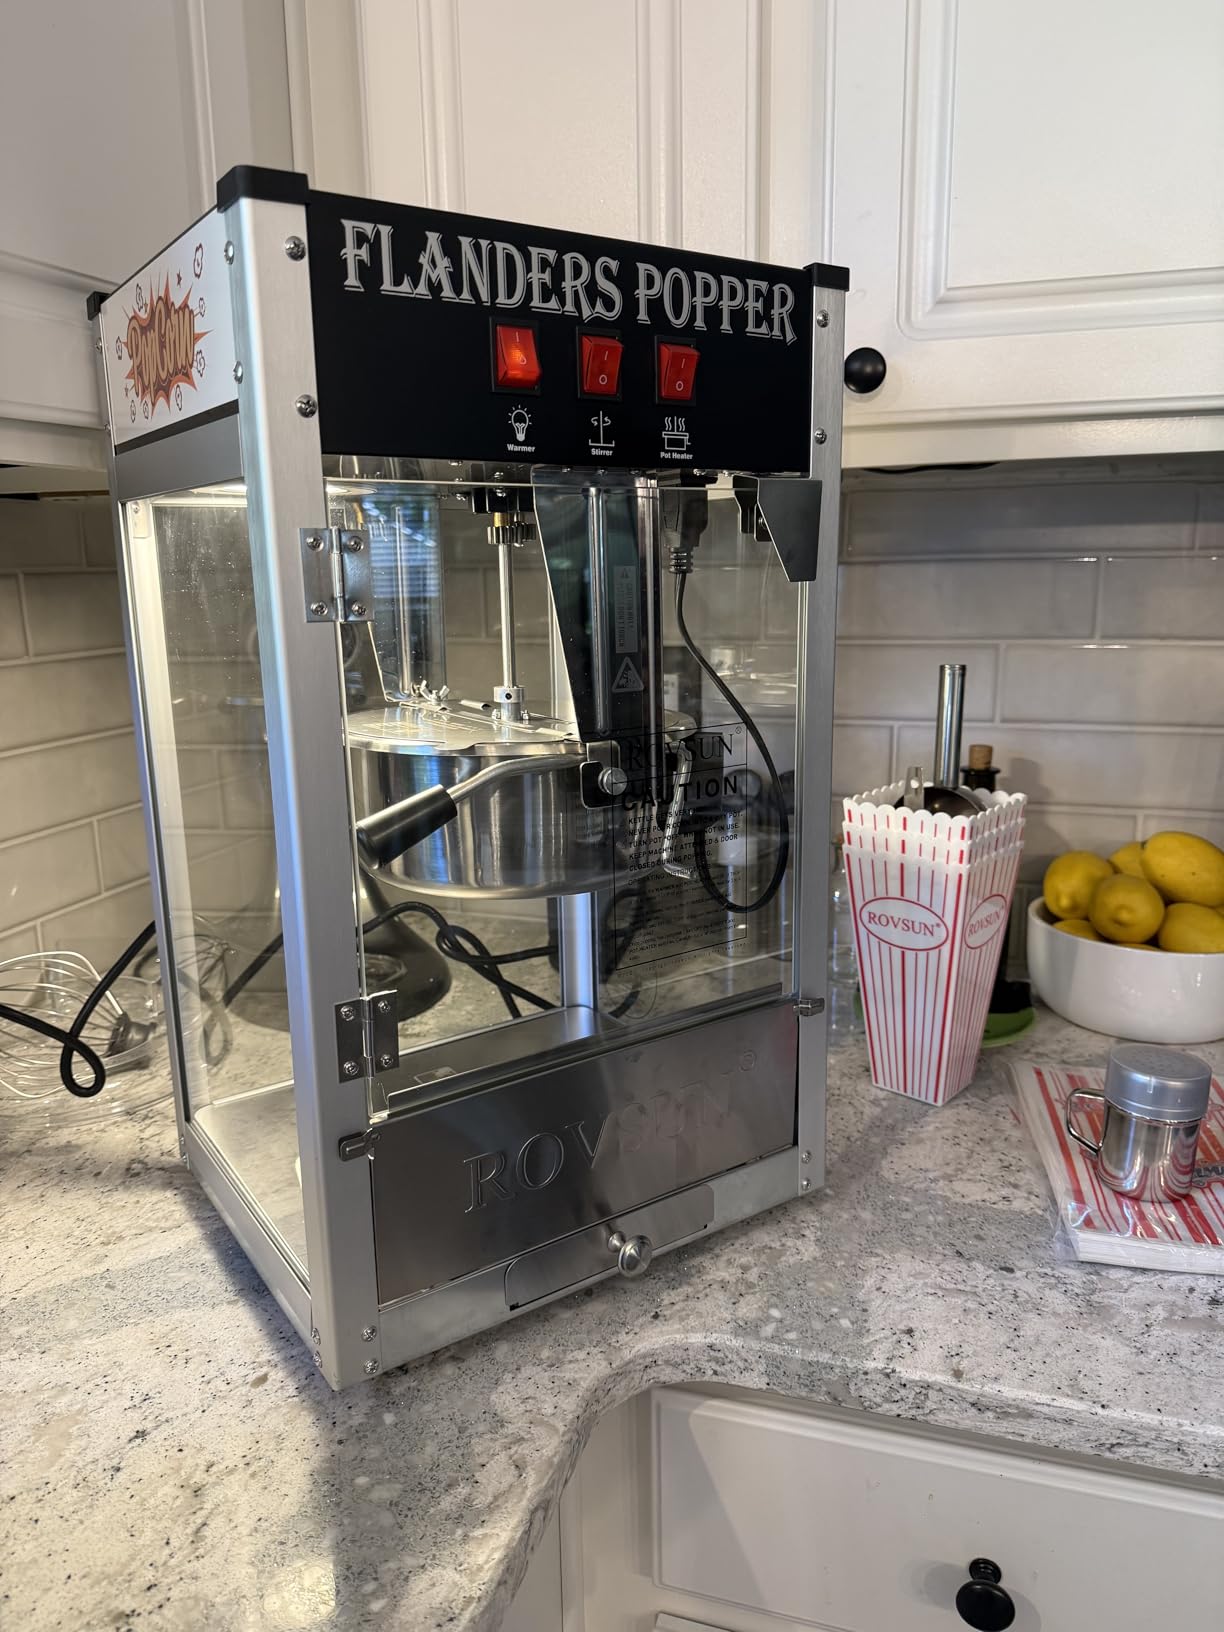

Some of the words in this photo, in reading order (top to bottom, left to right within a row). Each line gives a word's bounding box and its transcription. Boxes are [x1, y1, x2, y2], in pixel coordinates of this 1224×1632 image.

[340, 218, 623, 323] FLANDERS
[634, 262, 798, 346] POPPER
[506, 443, 536, 453] Warmer
[591, 448, 613, 457] Stirrer
[660, 452, 671, 460] Pot
[672, 452, 693, 460] Heater
[622, 775, 738, 811] CAUTION
[628, 814, 654, 825] KETTLE
[628, 826, 651, 837] NEVER
[629, 840, 647, 849] TURN
[629, 850, 647, 860] KEEP
[720, 833, 738, 842] DOOR
[629, 861, 656, 871] CLOSED
